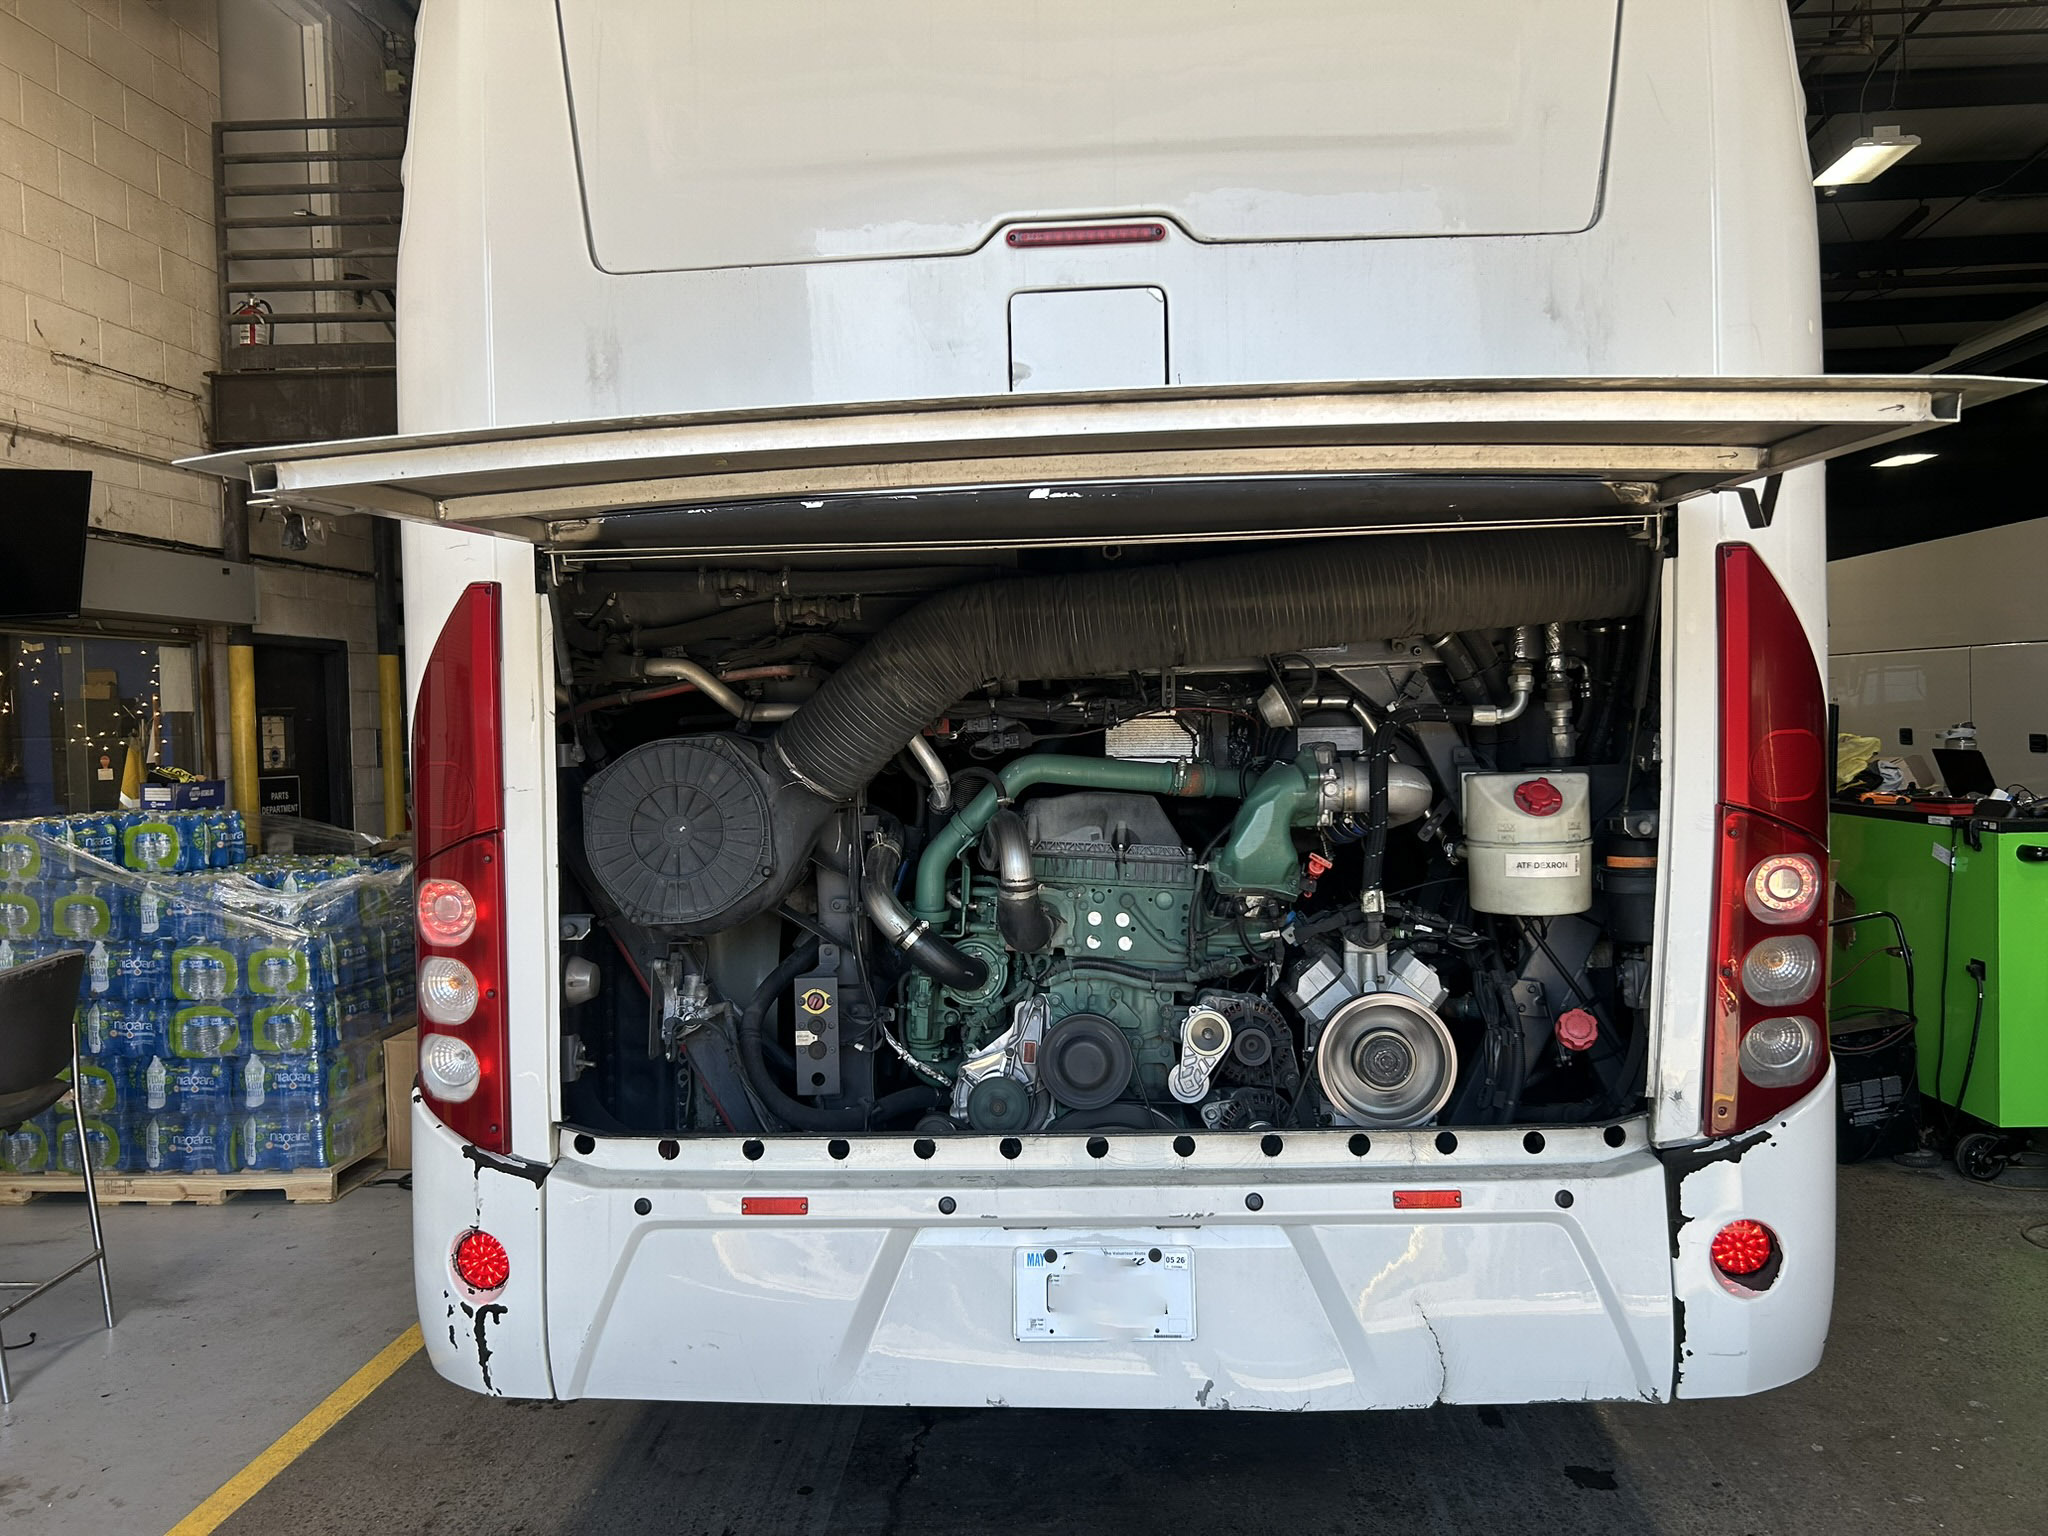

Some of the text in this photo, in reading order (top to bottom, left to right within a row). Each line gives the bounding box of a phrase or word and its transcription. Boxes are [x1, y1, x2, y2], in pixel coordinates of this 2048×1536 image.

[271, 791, 289, 800] PARTS
[262, 804, 298, 815] DEPARTMENT
[1516, 861, 1532, 869] ATF
[1533, 861, 1568, 869] DEXRON
[1026, 1252, 1044, 1267] MAY
[1165, 1256, 1186, 1264] 05 26
